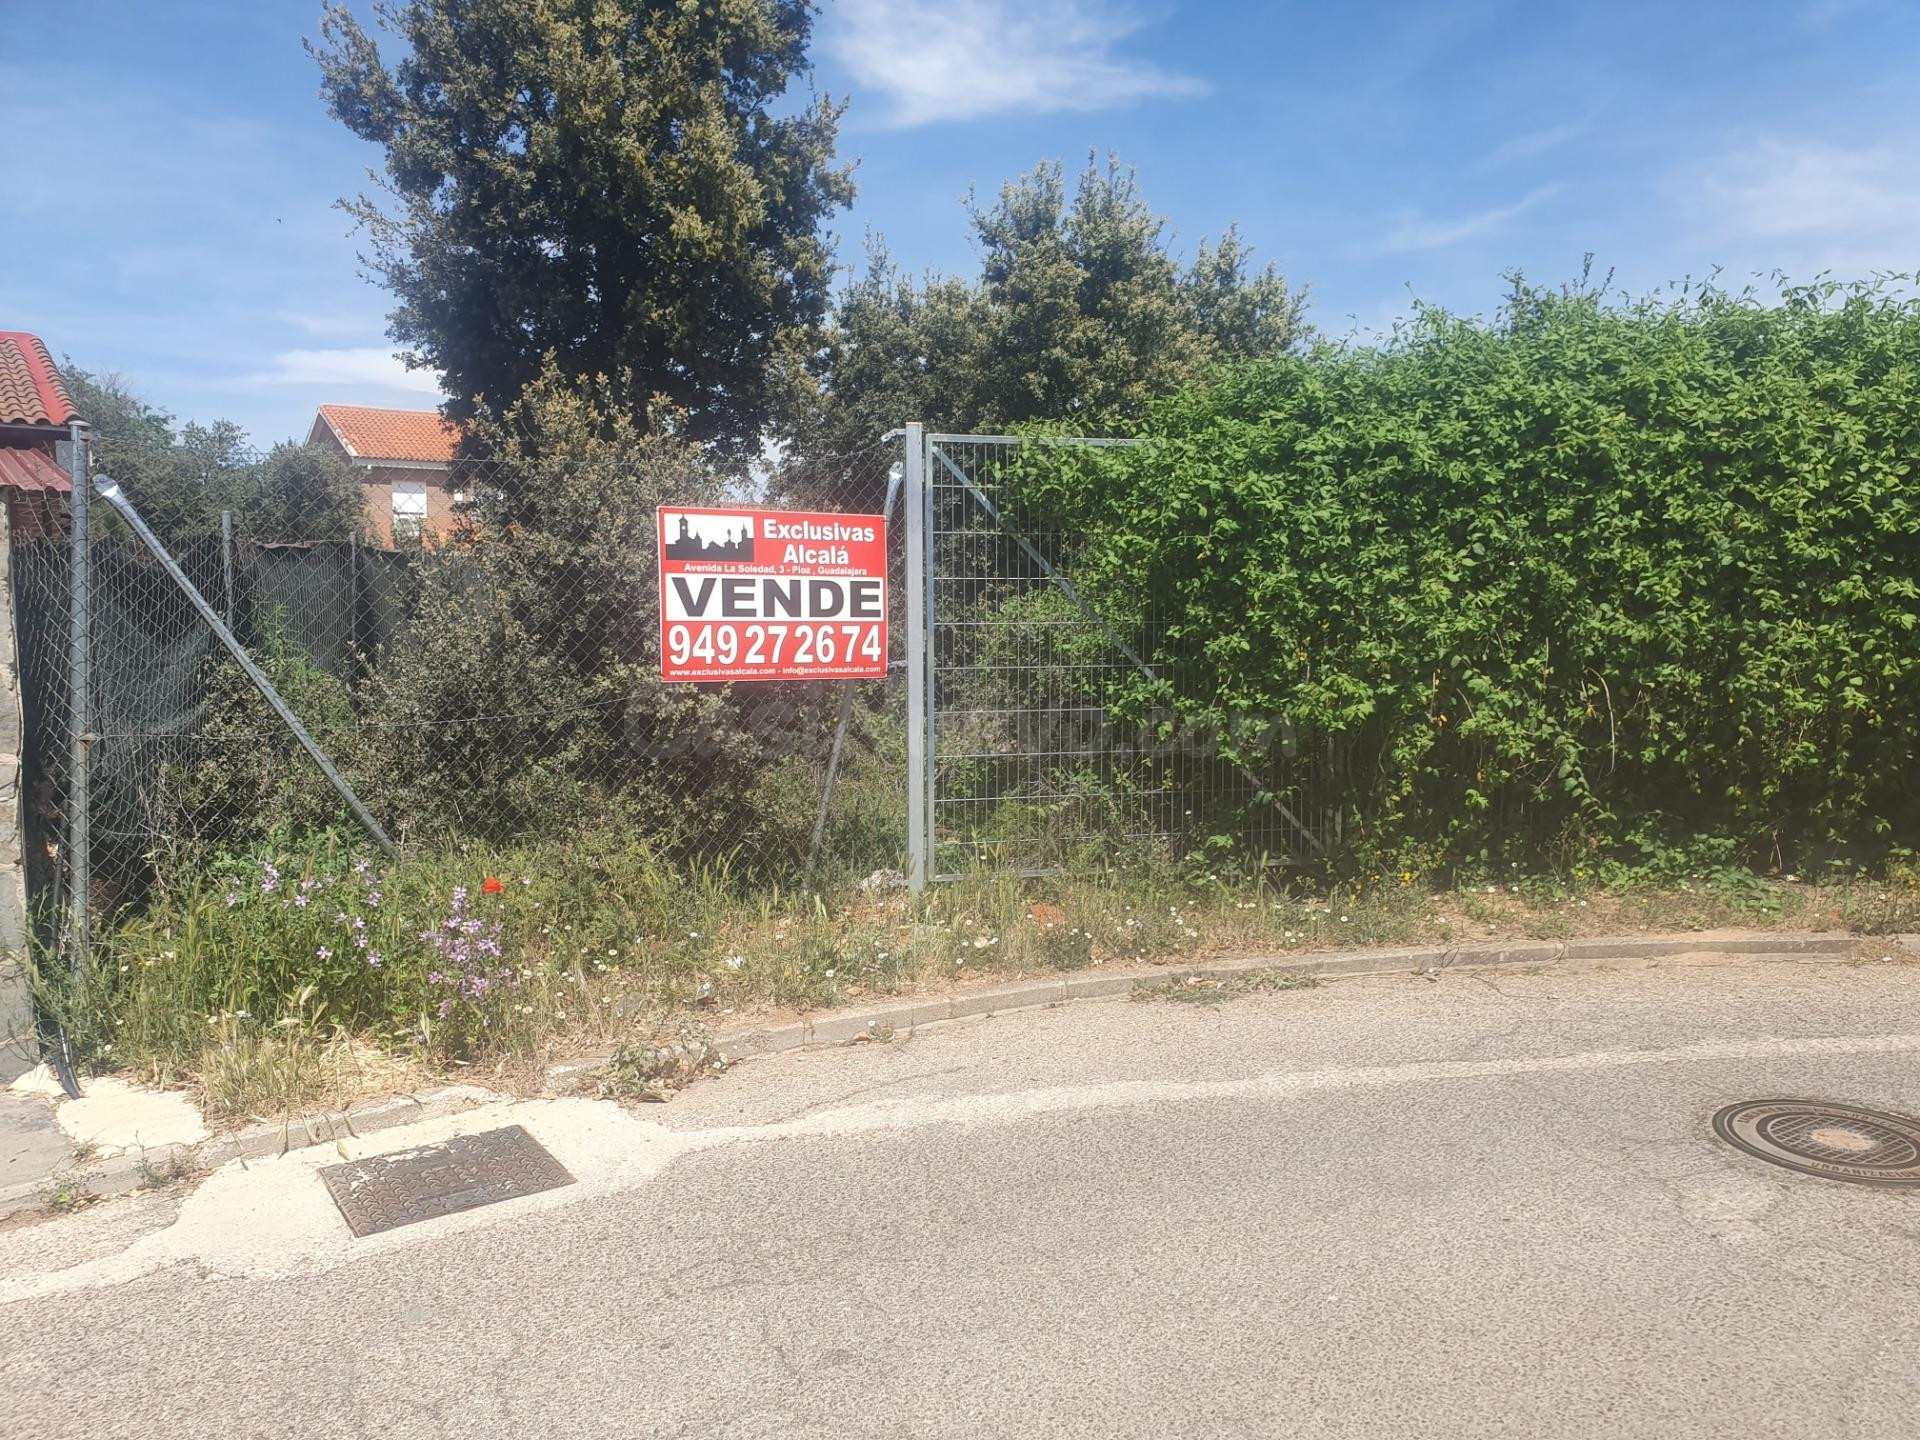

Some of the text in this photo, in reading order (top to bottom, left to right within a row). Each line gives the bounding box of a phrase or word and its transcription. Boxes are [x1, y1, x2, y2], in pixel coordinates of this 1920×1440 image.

[763, 518, 875, 542] Exclusivas
[783, 544, 849, 565] Alcalá
[684, 563, 722, 573] Avenida
[725, 564, 737, 573] La
[738, 564, 777, 575] Soledad,
[779, 566, 785, 574] 3
[818, 567, 867, 576] Guadalajara
[672, 577, 882, 618] VENDE
[669, 624, 882, 665] 949 27 26 74
[670, 667, 776, 676] www.exclusivasalcala.com
[783, 666, 881, 675] info@exclusivasalcala.com
